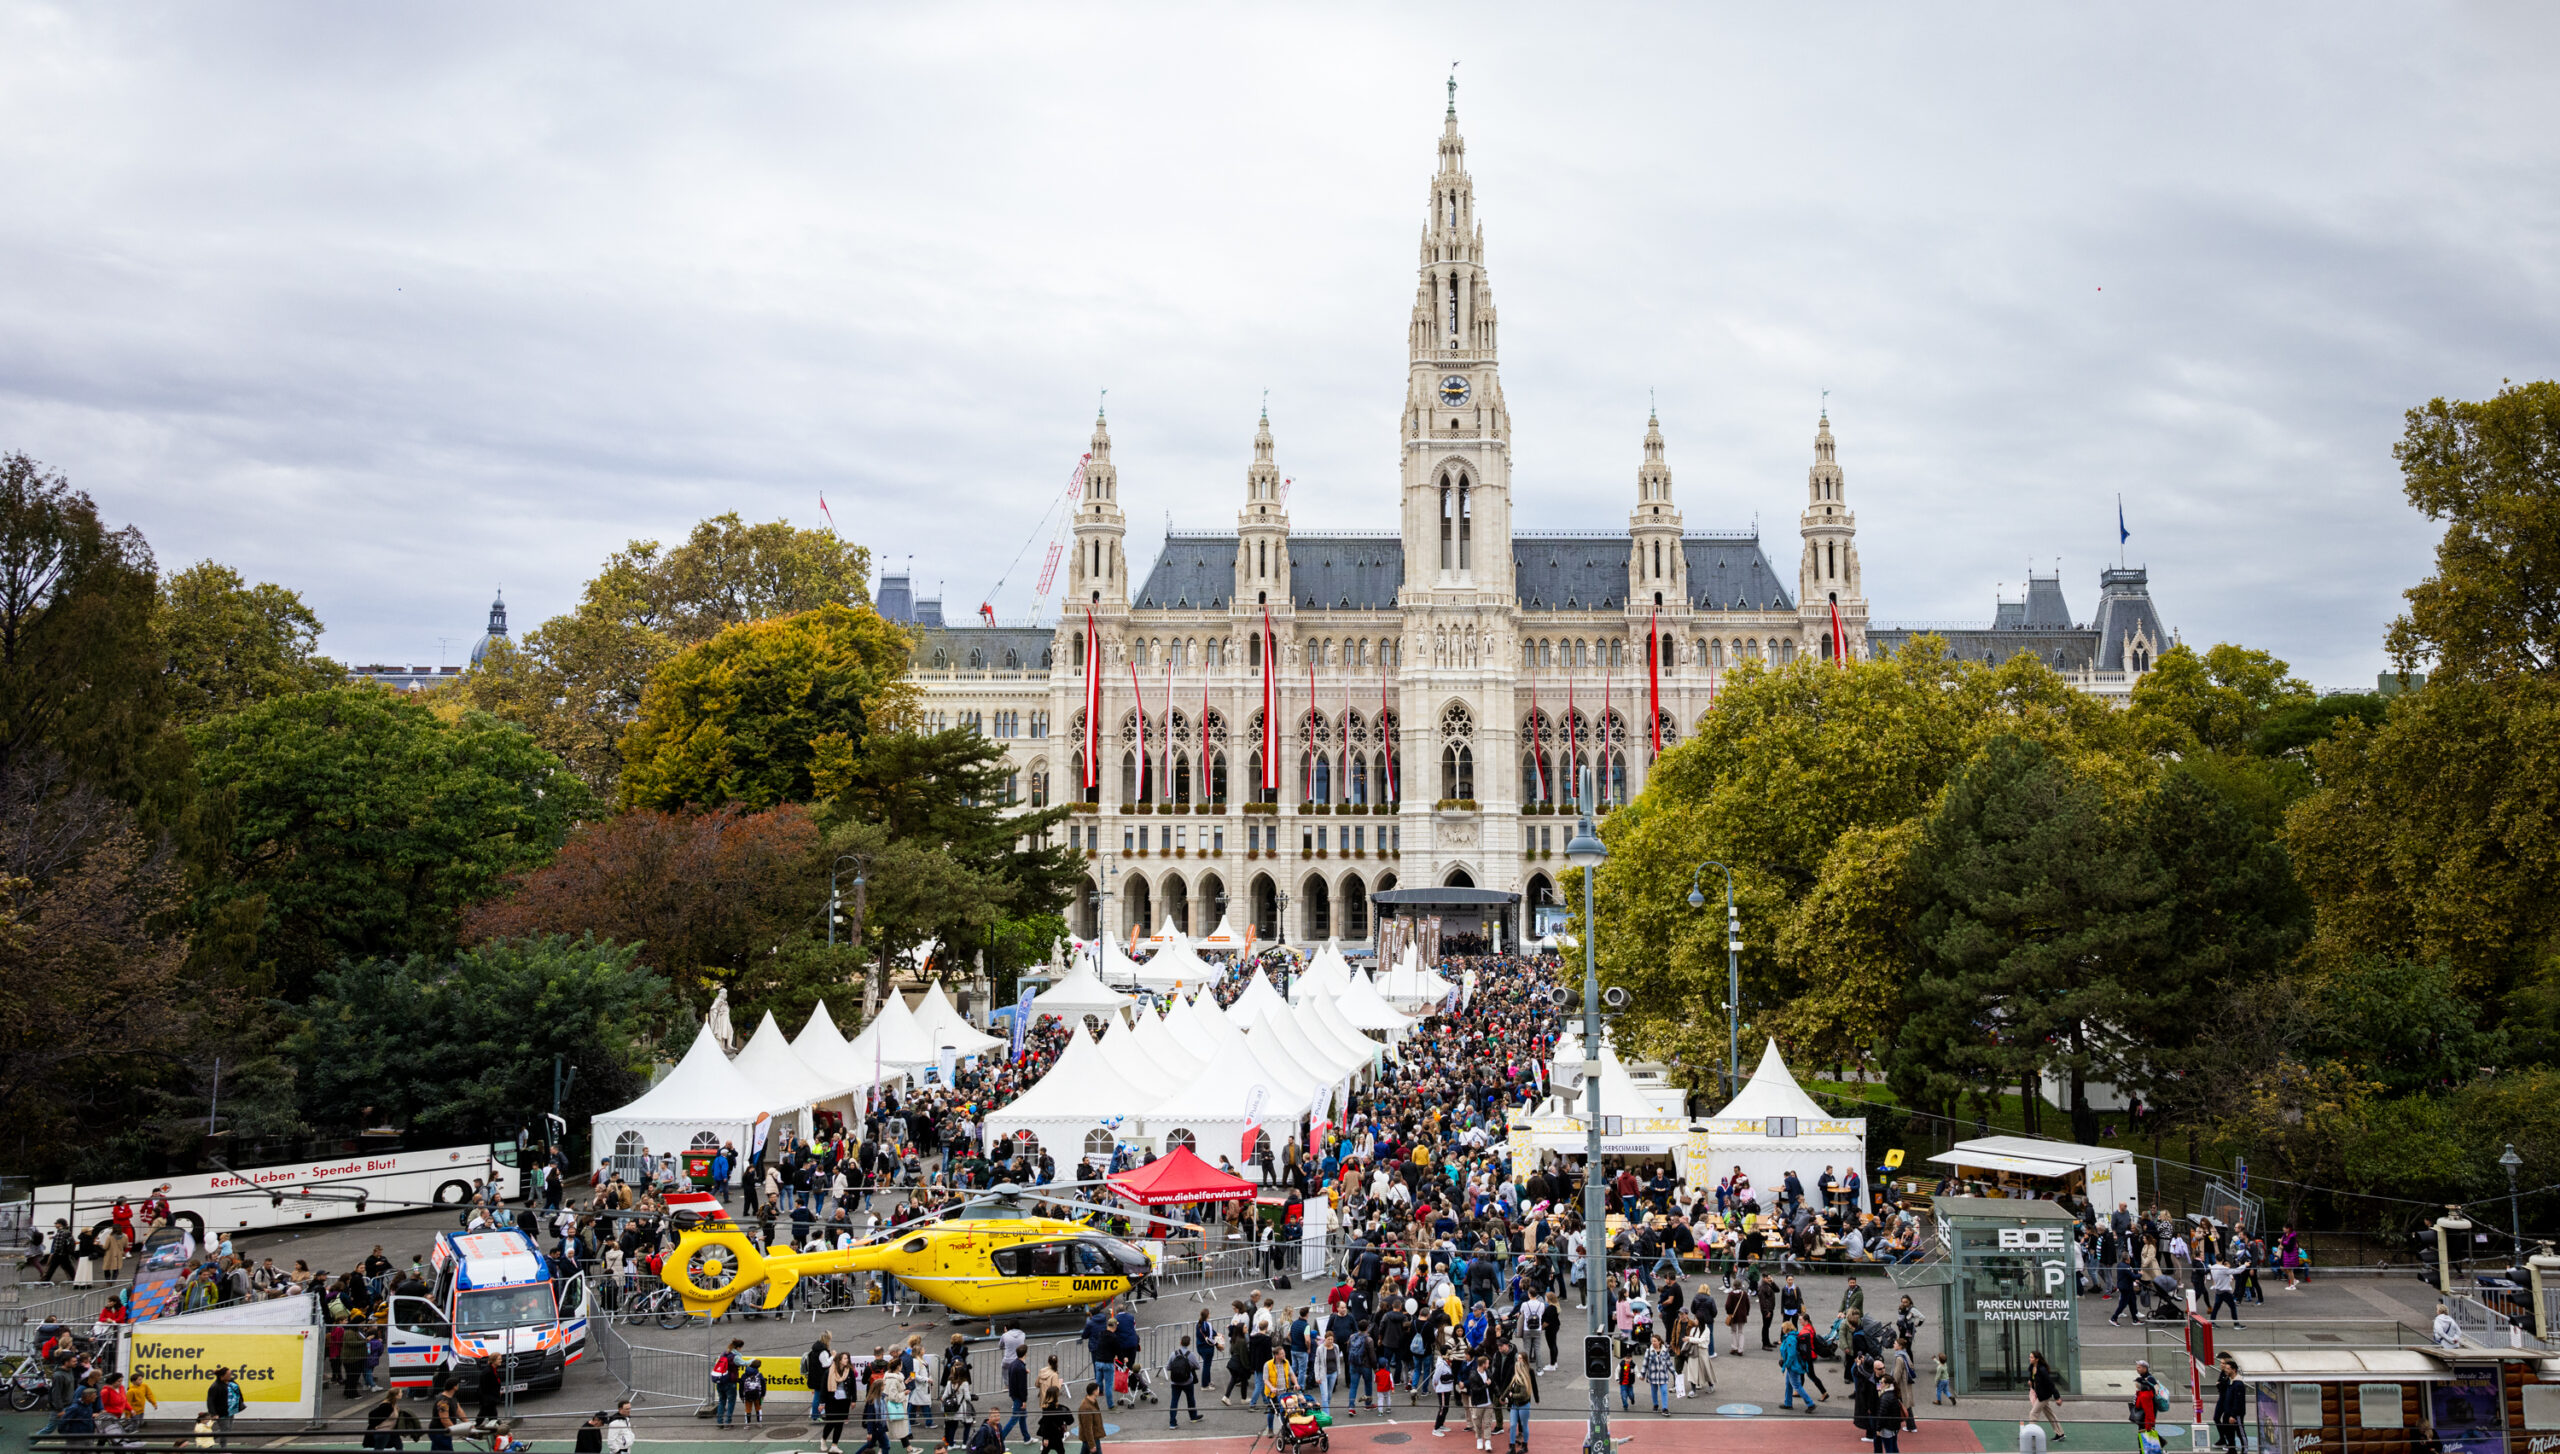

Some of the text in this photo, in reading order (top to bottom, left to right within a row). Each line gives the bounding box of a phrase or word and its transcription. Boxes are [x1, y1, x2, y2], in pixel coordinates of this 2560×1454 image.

[211, 1177, 248, 1188] Rette
[254, 1172, 295, 1184] Leben
[312, 1162, 362, 1179] Spende
[367, 1158, 396, 1171] Blut!
[1147, 1189, 1252, 1203] www.diehelferwiens.at
[1998, 1228, 2065, 1248] BOE
[2044, 1268, 2065, 1294] P
[1977, 1300, 2070, 1310] PARKEN UNTERM
[1984, 1311, 2070, 1321] RATHAUSPLATZ
[135, 1342, 205, 1359] Wiener
[134, 1363, 275, 1381] Sicherhesfest
[2528, 1434, 2560, 1454] Milk
